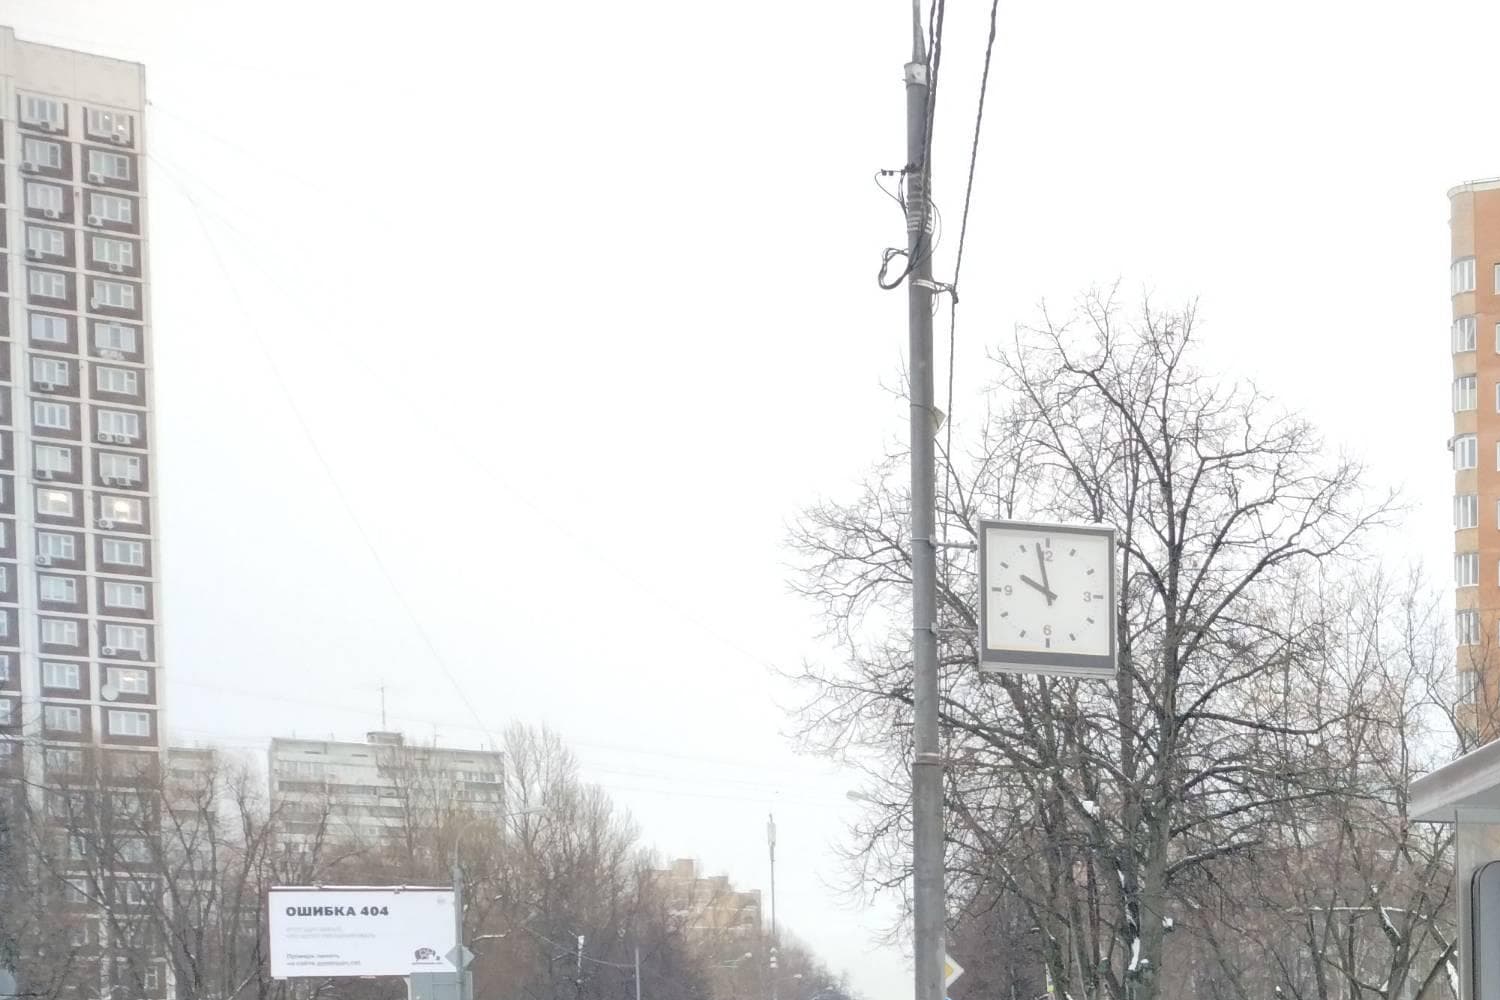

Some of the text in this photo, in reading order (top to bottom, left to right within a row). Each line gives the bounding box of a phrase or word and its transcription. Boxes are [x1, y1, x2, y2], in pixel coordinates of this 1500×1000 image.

[1004, 585, 1012, 596] 9
[1083, 591, 1091, 602] 3
[1043, 624, 1052, 636] 6
[286, 906, 389, 917] ОШИБКА 404
